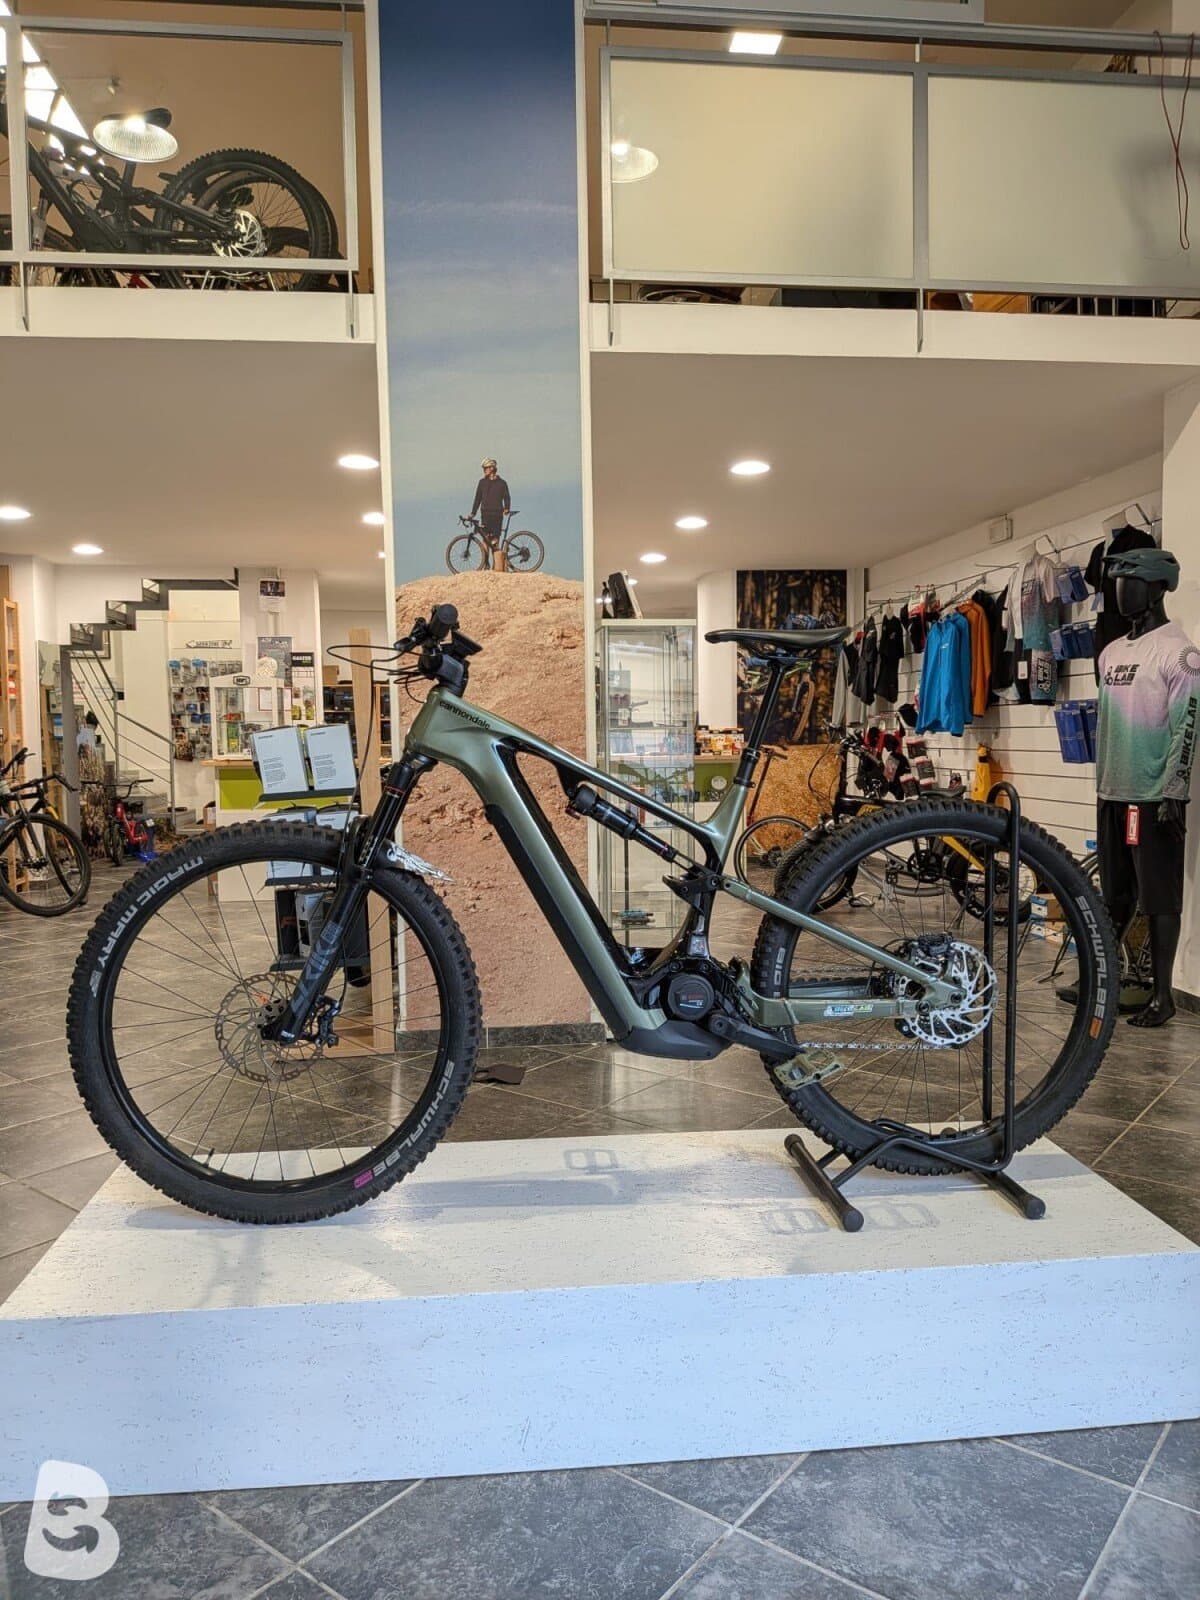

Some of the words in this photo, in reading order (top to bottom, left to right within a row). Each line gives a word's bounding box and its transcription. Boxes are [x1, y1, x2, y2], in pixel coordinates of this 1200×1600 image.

[1114, 664, 1140, 673] BIKE
[1114, 672, 1136, 682] LAB
[440, 701, 491, 730] cannondale
[1186, 696, 1198, 728] LAB
[1180, 728, 1193, 765] BIKE
[137, 856, 204, 906] MAGIC
[98, 904, 138, 968] MARY
[1075, 895, 1107, 1019] SCHWALBE
[373, 1059, 455, 1176] SCHWALBE
